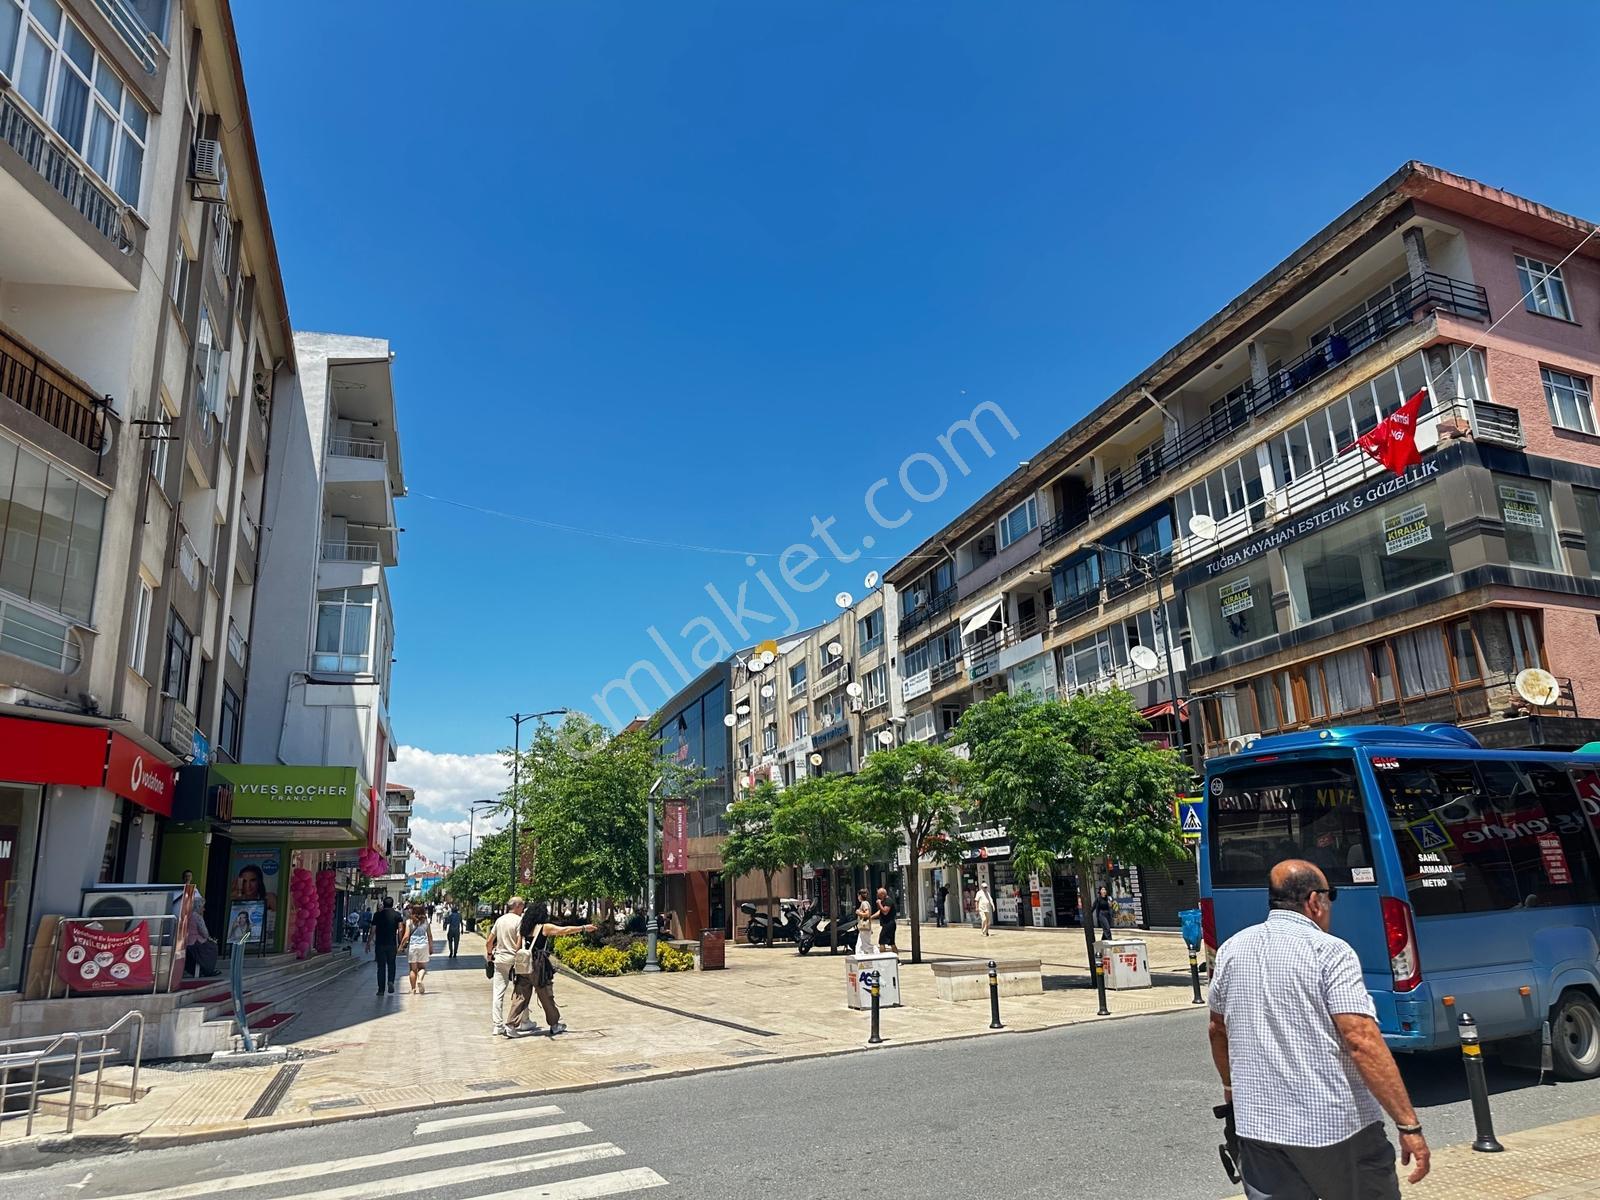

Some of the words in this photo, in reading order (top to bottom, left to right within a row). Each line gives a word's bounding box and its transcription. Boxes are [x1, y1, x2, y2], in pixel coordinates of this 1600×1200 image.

[1206, 552, 1242, 575] TUĞBA
[1243, 526, 1296, 559] KAYAHAN
[1298, 501, 1351, 533] ESTETİK
[1353, 496, 1363, 508] &
[1366, 460, 1440, 502] GÜZELLİK
[142, 771, 164, 795] vodafone
[240, 784, 279, 795] YVES
[284, 785, 347, 796] ROCHER
[1418, 852, 1441, 862] SAHİL
[1419, 865, 1453, 874] ARMARAY
[1422, 878, 1447, 887] METRO
